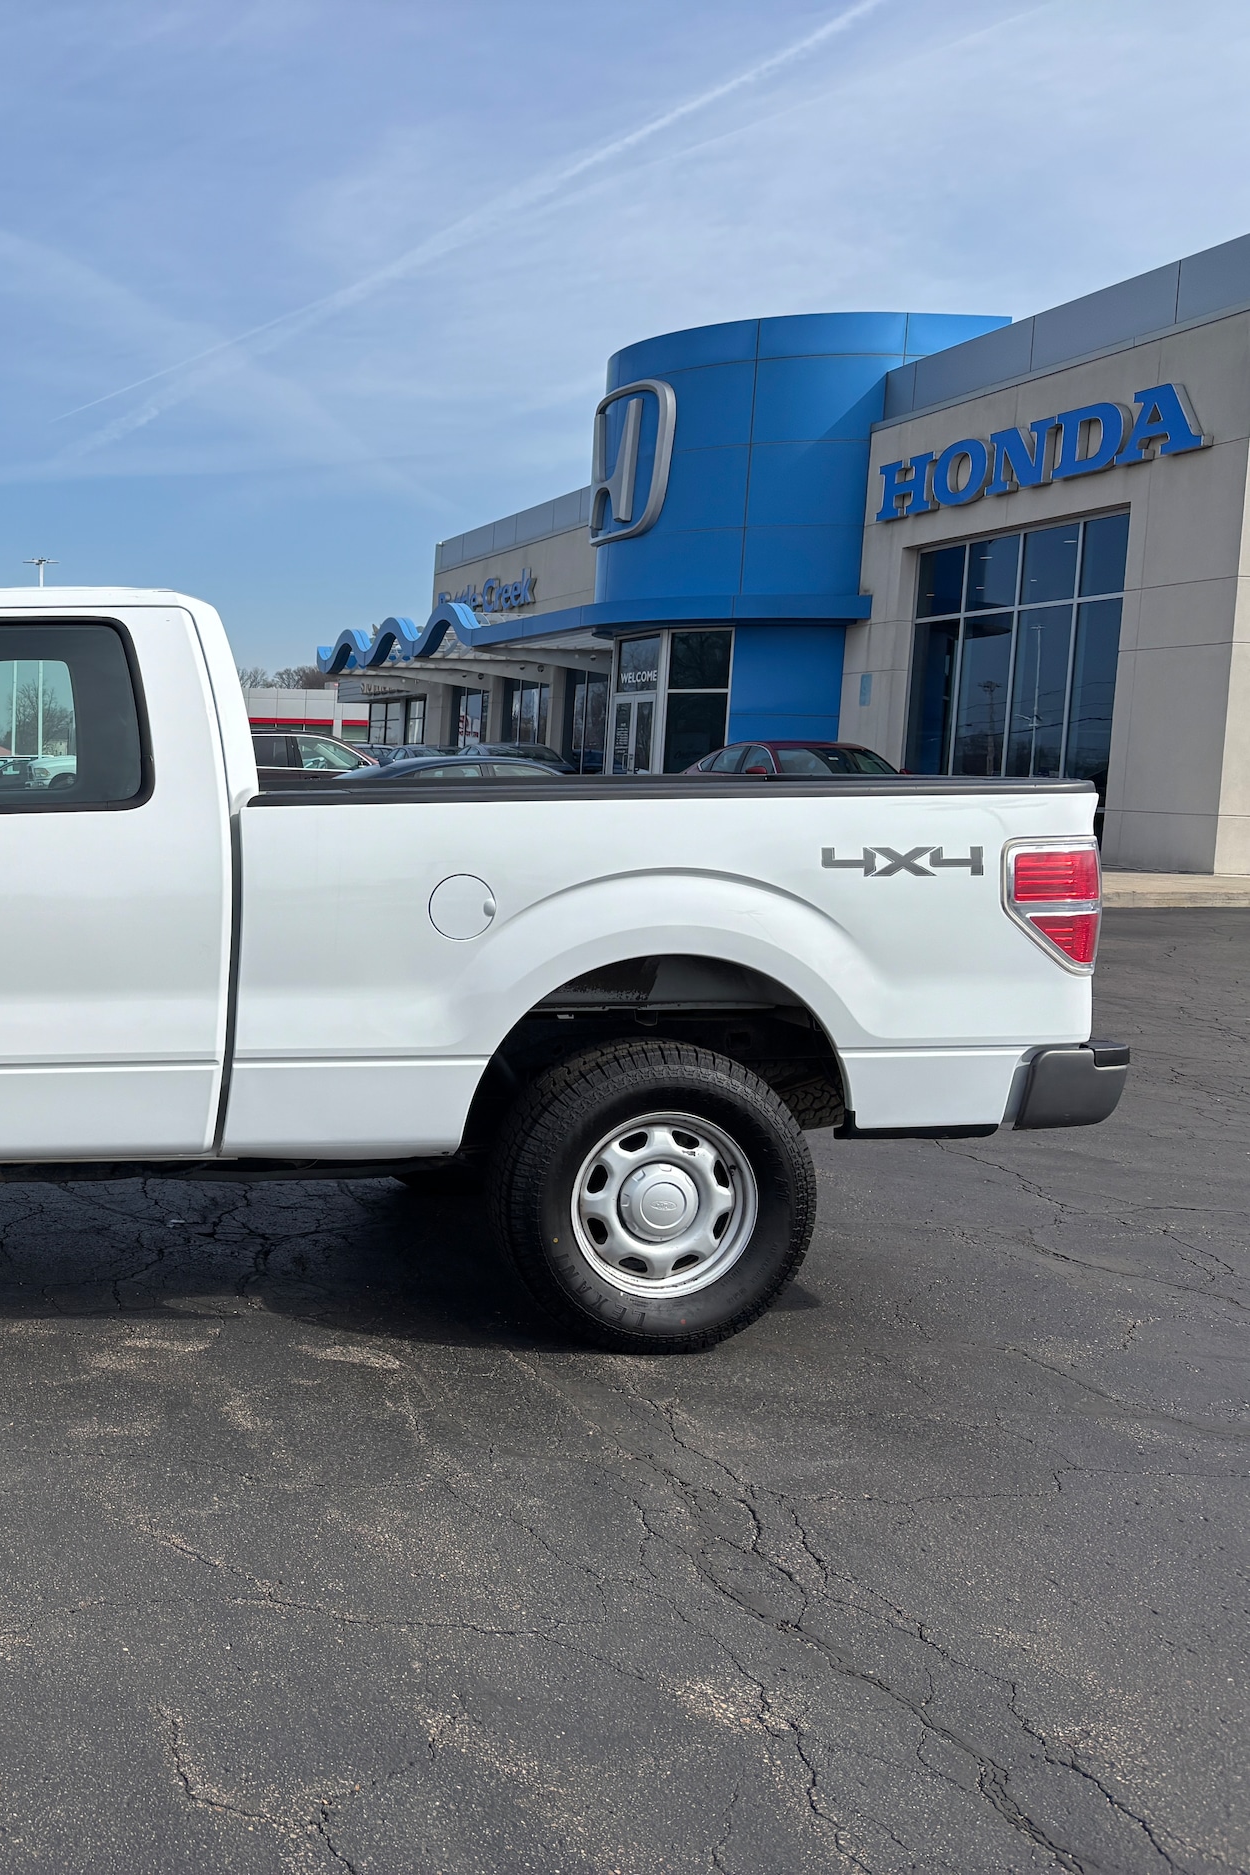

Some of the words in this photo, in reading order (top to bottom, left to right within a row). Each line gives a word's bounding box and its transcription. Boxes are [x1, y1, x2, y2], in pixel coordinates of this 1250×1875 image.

[876, 383, 1213, 522] HONDA
[482, 567, 537, 612] Creek
[620, 670, 658, 683] WELCOME
[821, 846, 984, 878] 4X4
[553, 1253, 647, 1329] LEXANI
